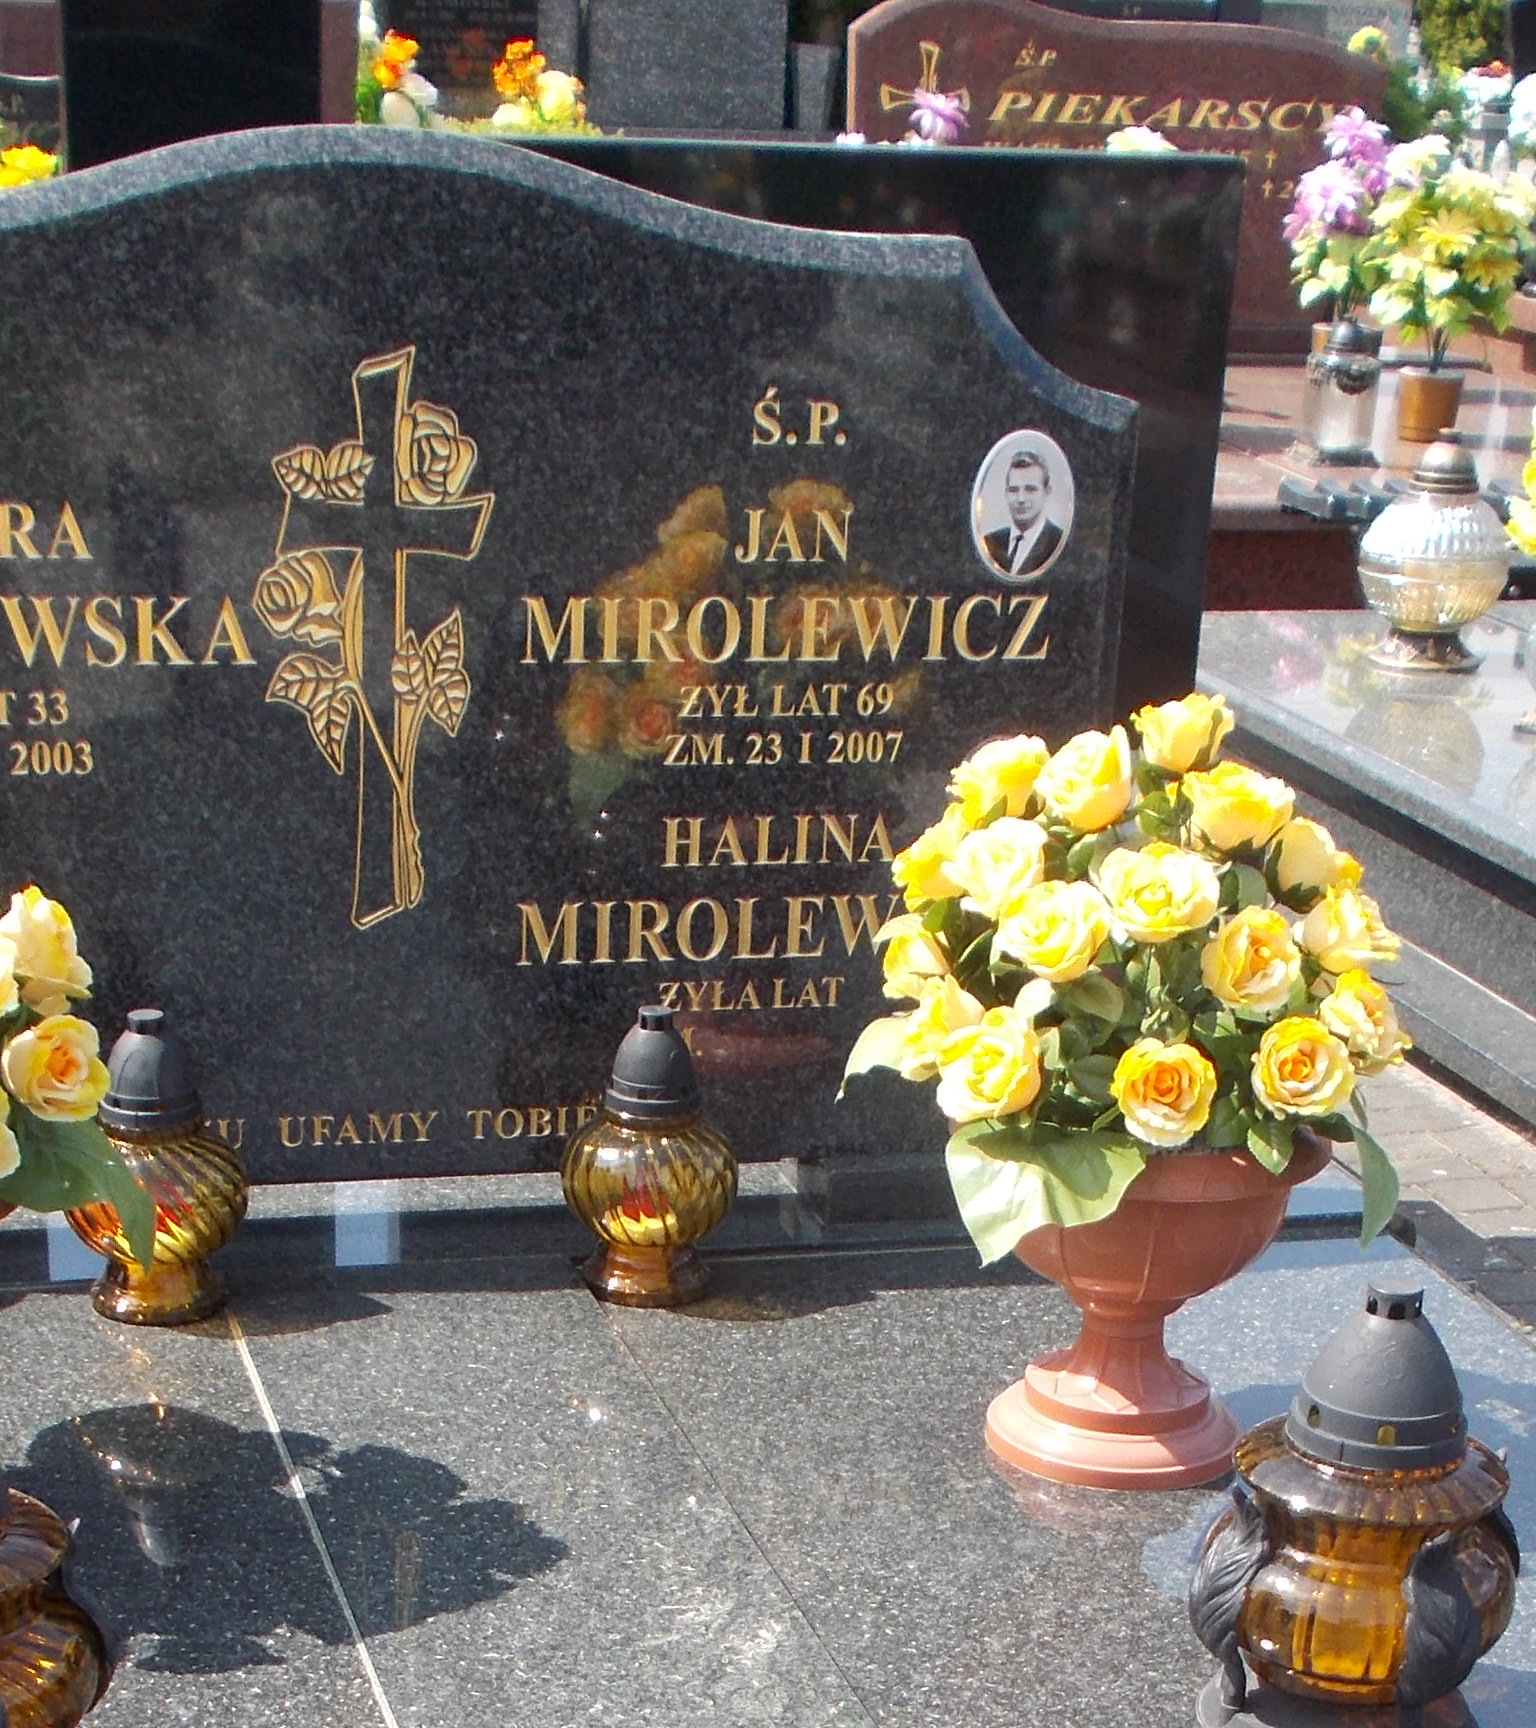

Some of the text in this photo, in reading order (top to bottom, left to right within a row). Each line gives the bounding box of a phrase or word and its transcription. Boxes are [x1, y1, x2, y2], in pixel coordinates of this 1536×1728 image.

[752, 385, 848, 447] Ś.P.
[734, 507, 854, 564] JAN
[521, 595, 1050, 665] MIROLEWICZ
[27, 688, 70, 726] 33
[769, 683, 848, 717] LAT
[856, 682, 894, 717] 69
[9, 739, 93, 776] 2003
[663, 729, 904, 766] ZM. 23 I 2007
[661, 811, 895, 868] HALINA
[770, 976, 846, 1009] LAT
[278, 1110, 440, 1149] UFAMY
